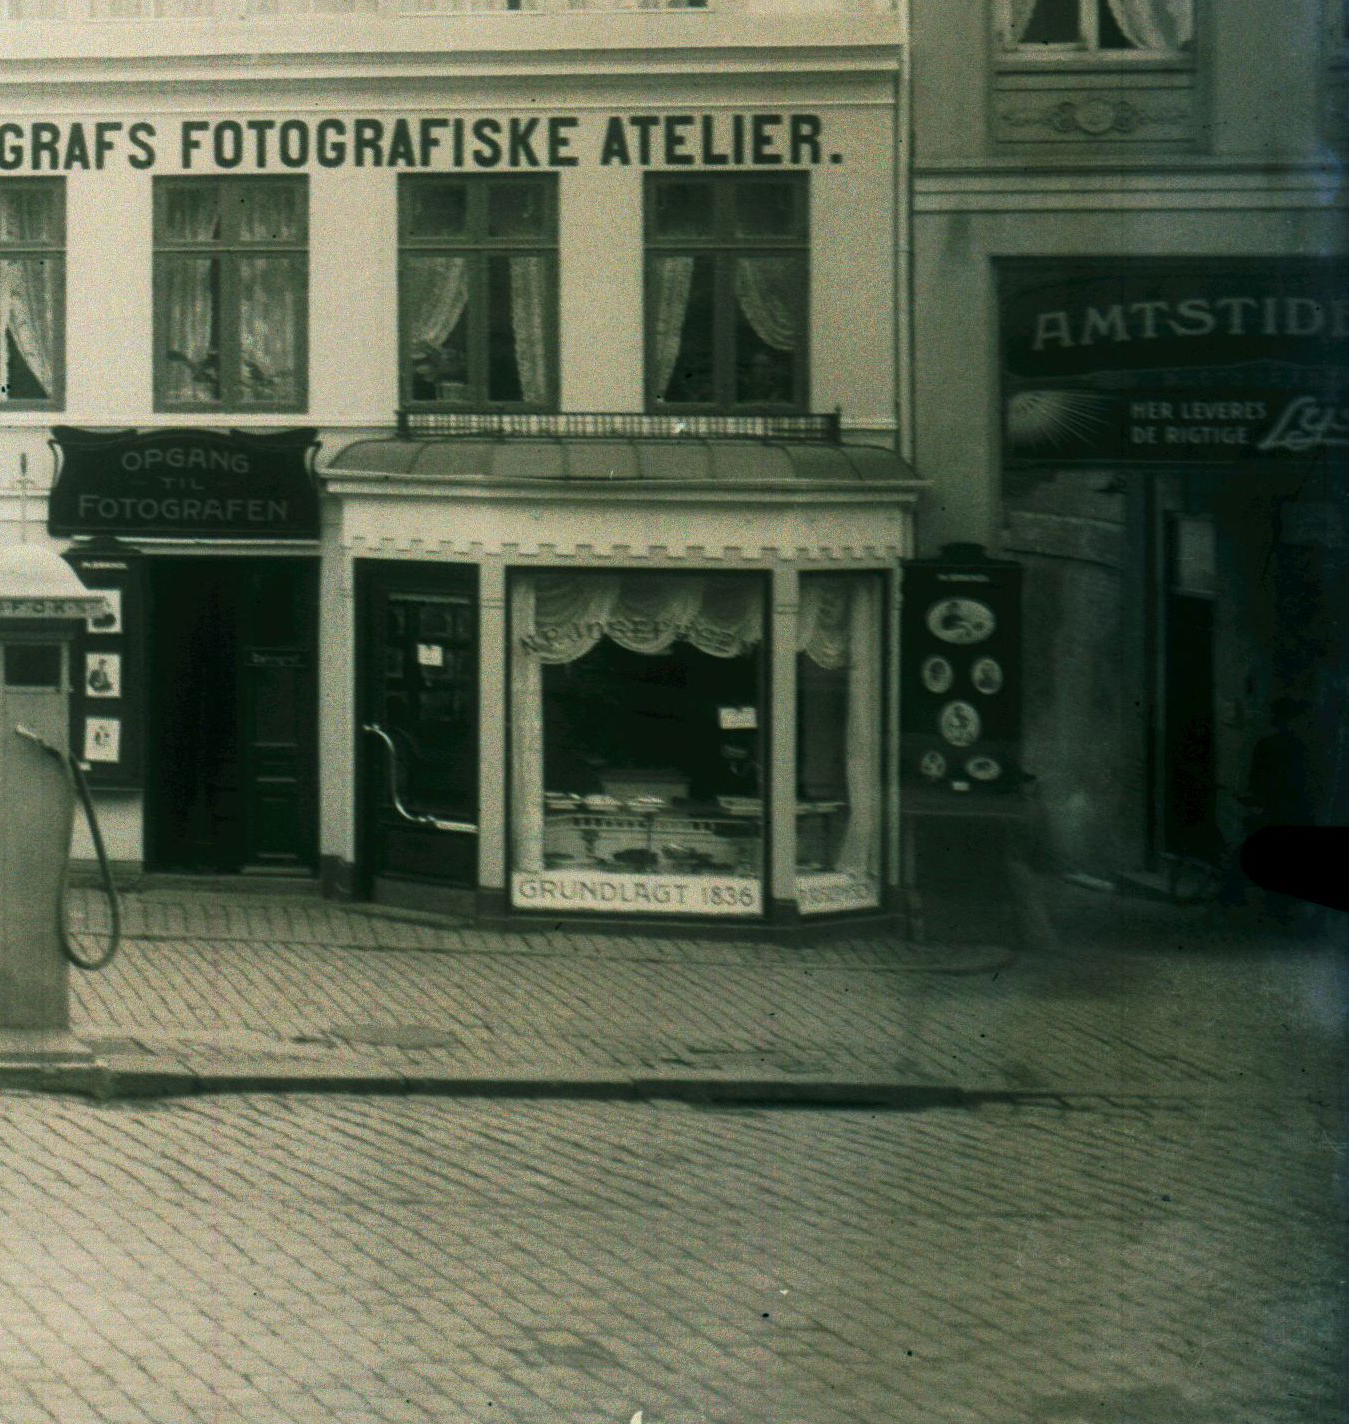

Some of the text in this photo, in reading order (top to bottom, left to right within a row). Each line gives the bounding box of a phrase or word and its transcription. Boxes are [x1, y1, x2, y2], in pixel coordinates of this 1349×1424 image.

[181, 116, 580, 170] FOTOGRAFISKE
[599, 113, 844, 167] ATELIER.
[1130, 401, 1268, 421] HER LEVERES
[1130, 426, 1250, 445] DE RIGTIGE
[121, 447, 251, 474] OPGANG
[160, 477, 206, 491] TIL
[77, 493, 289, 522] FOTOGRAFEN
[518, 879, 755, 908] GRUNDLAGT 1836
